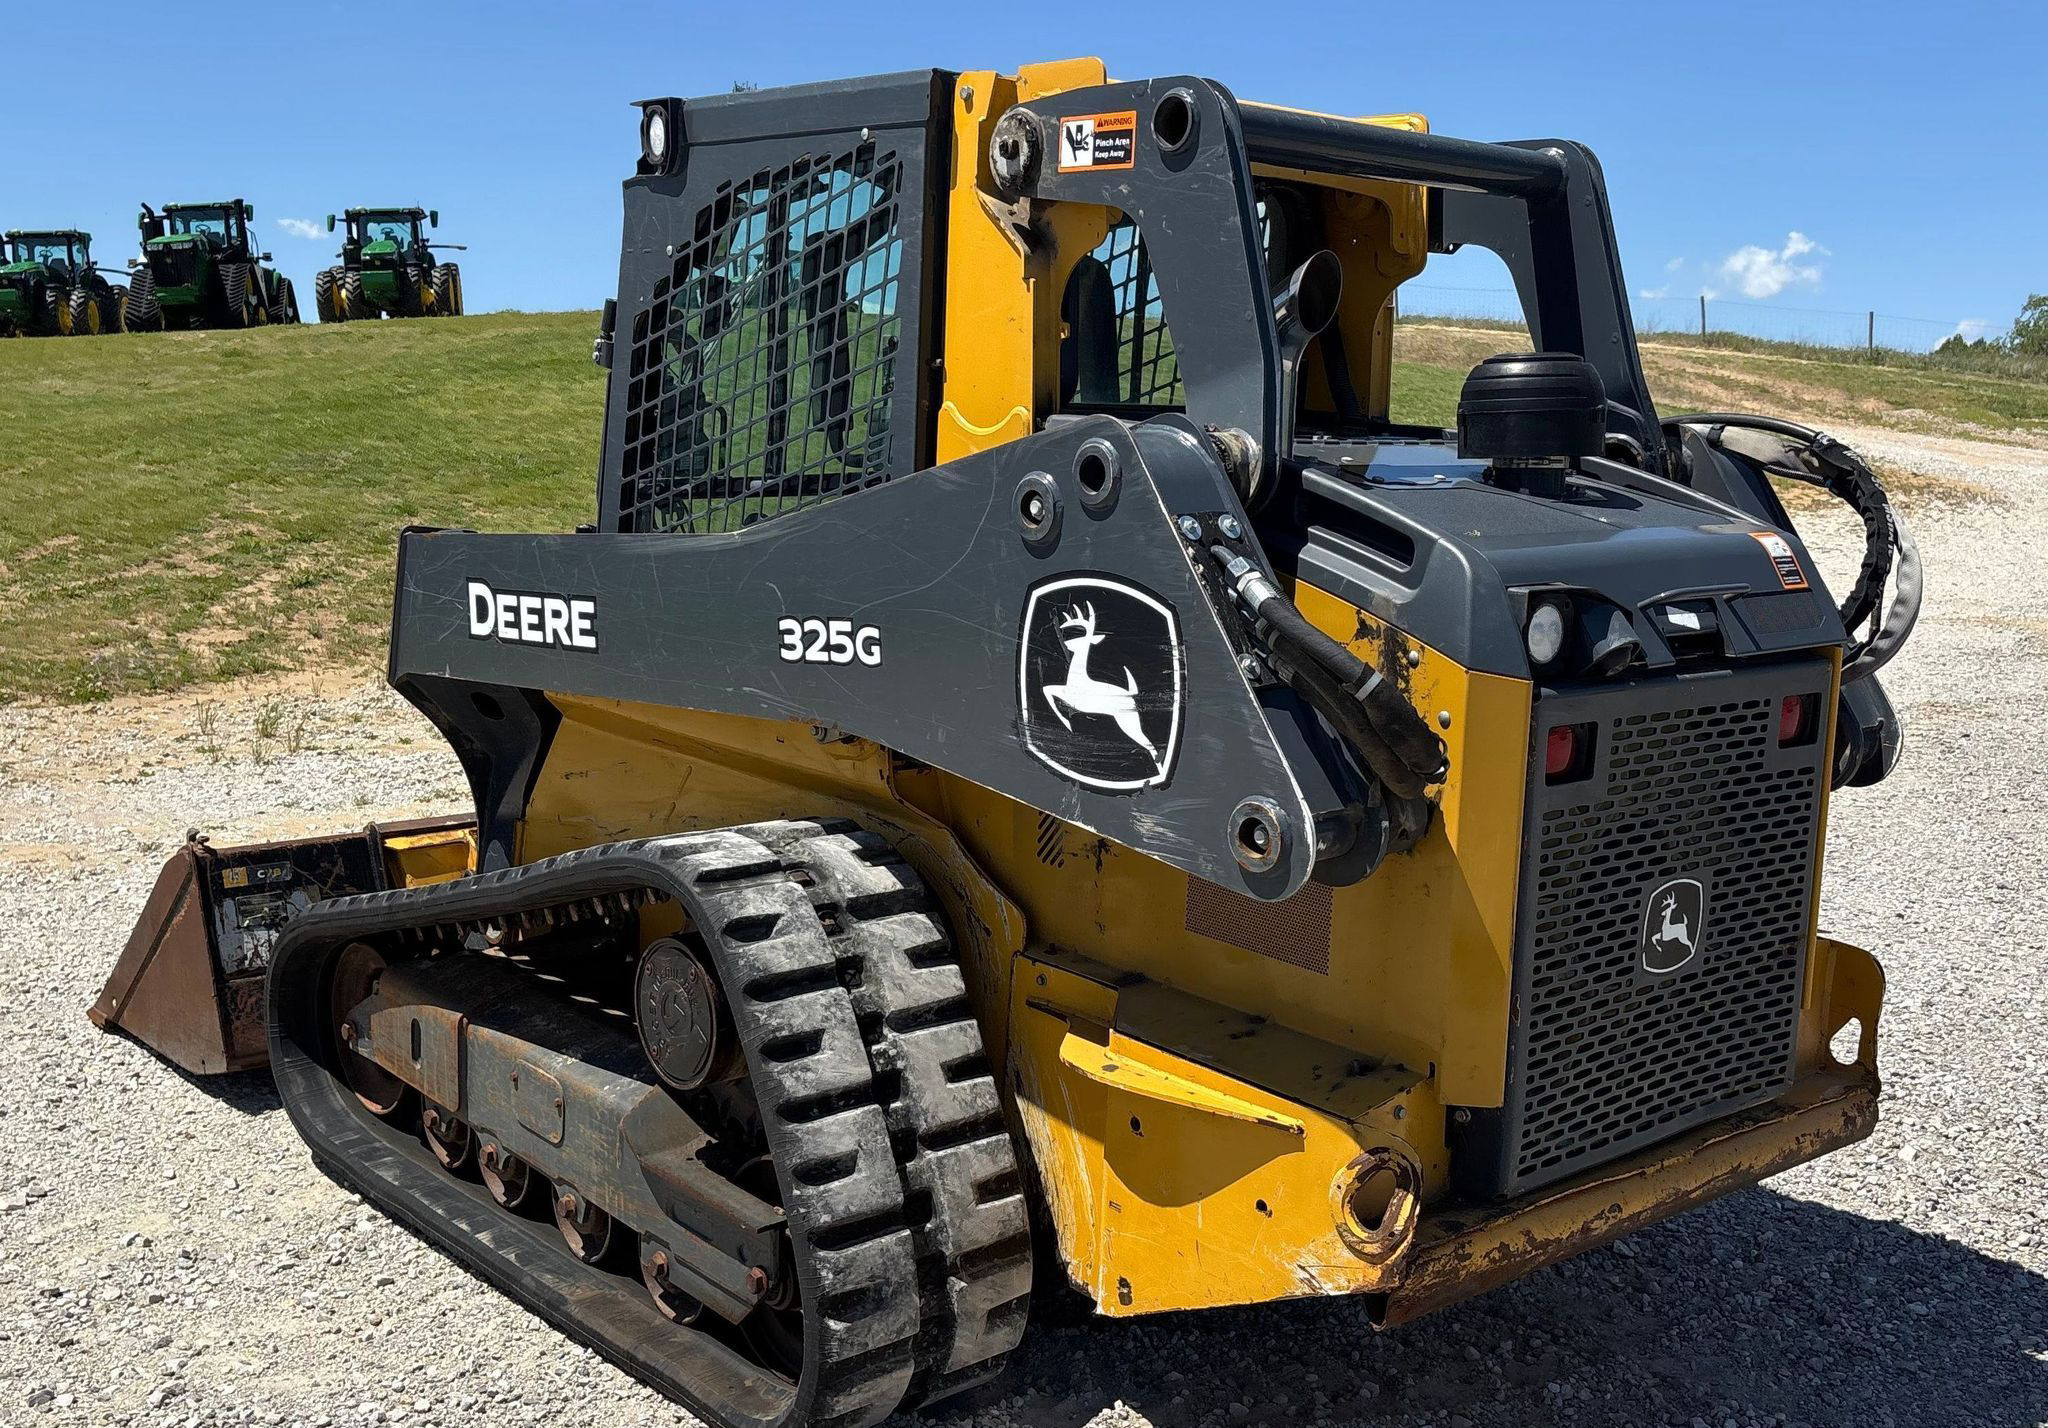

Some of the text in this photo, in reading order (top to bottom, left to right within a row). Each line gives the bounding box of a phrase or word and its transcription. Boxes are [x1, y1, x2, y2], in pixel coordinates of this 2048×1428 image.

[1103, 117, 1132, 127] WARNING
[1095, 137, 1130, 147] Pinch Area
[1094, 150, 1125, 159] Keep Away
[467, 581, 597, 649] DEERE
[778, 618, 881, 665] 325G
